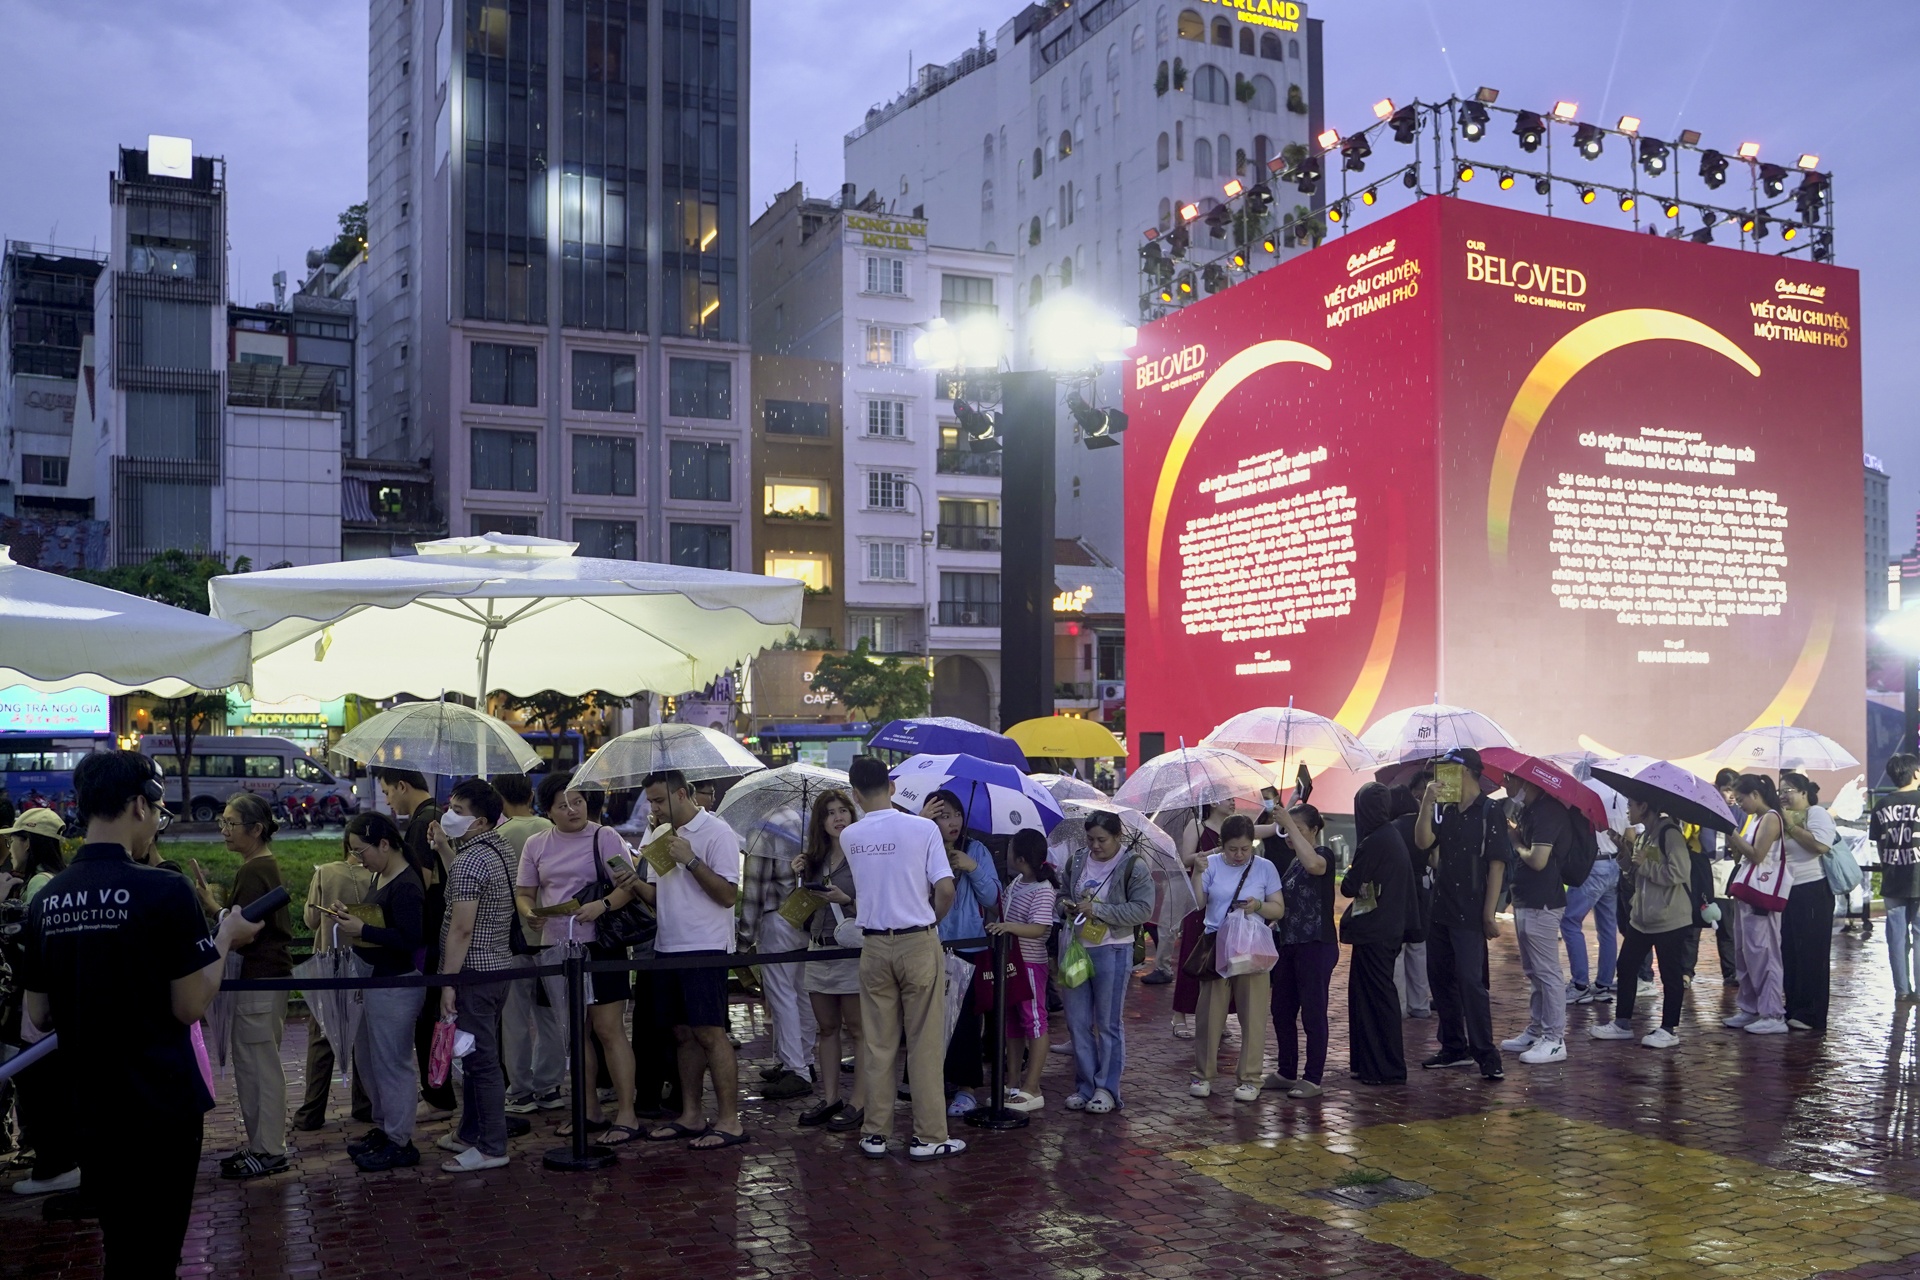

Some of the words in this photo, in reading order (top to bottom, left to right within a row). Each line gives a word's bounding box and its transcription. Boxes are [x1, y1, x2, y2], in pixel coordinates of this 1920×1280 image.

[1237, 11, 1299, 32] HOSPITALITY
[847, 215, 891, 233] SONG
[894, 222, 926, 236] ANH
[863, 232, 913, 250] HOTEL
[1466, 239, 1486, 251] OUR
[1466, 251, 1587, 297] BELOVED
[1324, 284, 1347, 308] VIẾT
[1346, 278, 1371, 299] CÂU
[1326, 306, 1352, 328] MỘT
[1352, 291, 1391, 318] THÀNH
[1392, 275, 1418, 304] PHỐ
[1514, 293, 1529, 304] HO
[1528, 295, 1544, 306] CHI
[1544, 297, 1566, 310] MINH
[1566, 301, 1586, 313] CITY
[1750, 299, 1776, 319] VIẾT
[1776, 304, 1802, 323] CÂU
[1753, 320, 1781, 341] MỘT
[1782, 325, 1821, 345] THÀNH
[1823, 330, 1848, 349] PHỐ
[1136, 343, 1206, 390] BELOVED
[81, 704, 101, 713] GIA
[243, 713, 285, 724] FACTORY
[242, 780, 277, 791] Luxury
[851, 843, 896, 855] BELOVED
[42, 890, 88, 913] TRAN
[99, 888, 130, 904] VO
[41, 908, 128, 929] PRODUCTION
